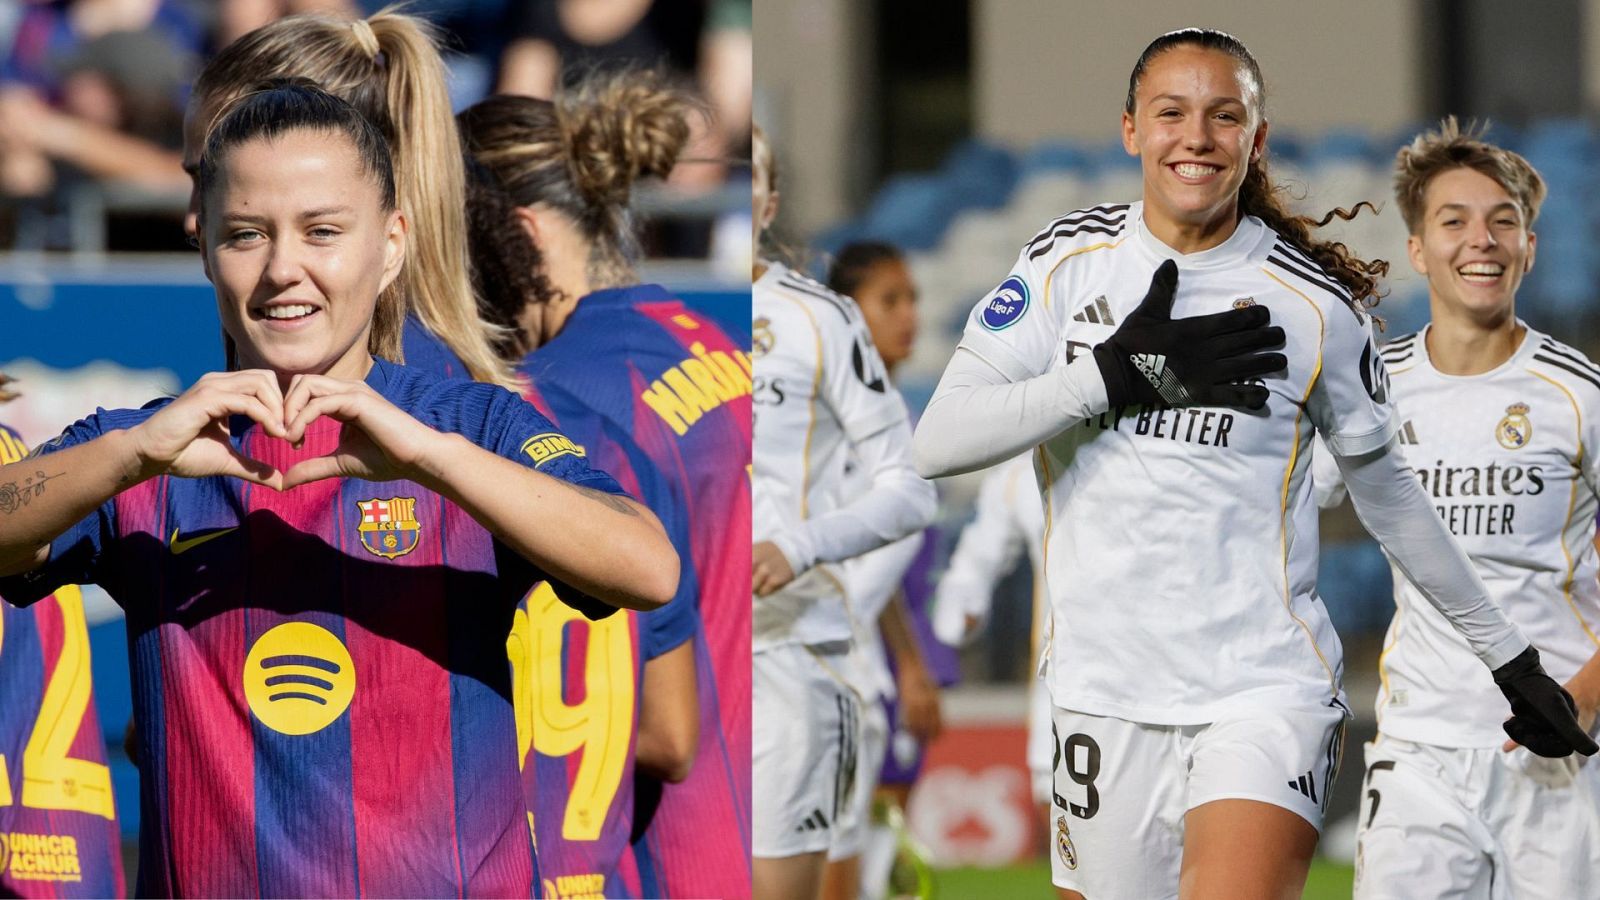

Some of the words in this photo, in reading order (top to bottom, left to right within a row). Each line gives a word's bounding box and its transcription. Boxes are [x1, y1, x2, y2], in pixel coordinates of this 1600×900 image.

[1129, 354, 1163, 389] adidas
[1135, 404, 1234, 448] BETTER
[1416, 459, 1546, 498] irates
[9, 832, 78, 856] UNHCR
[10, 853, 81, 874] ACNUR
